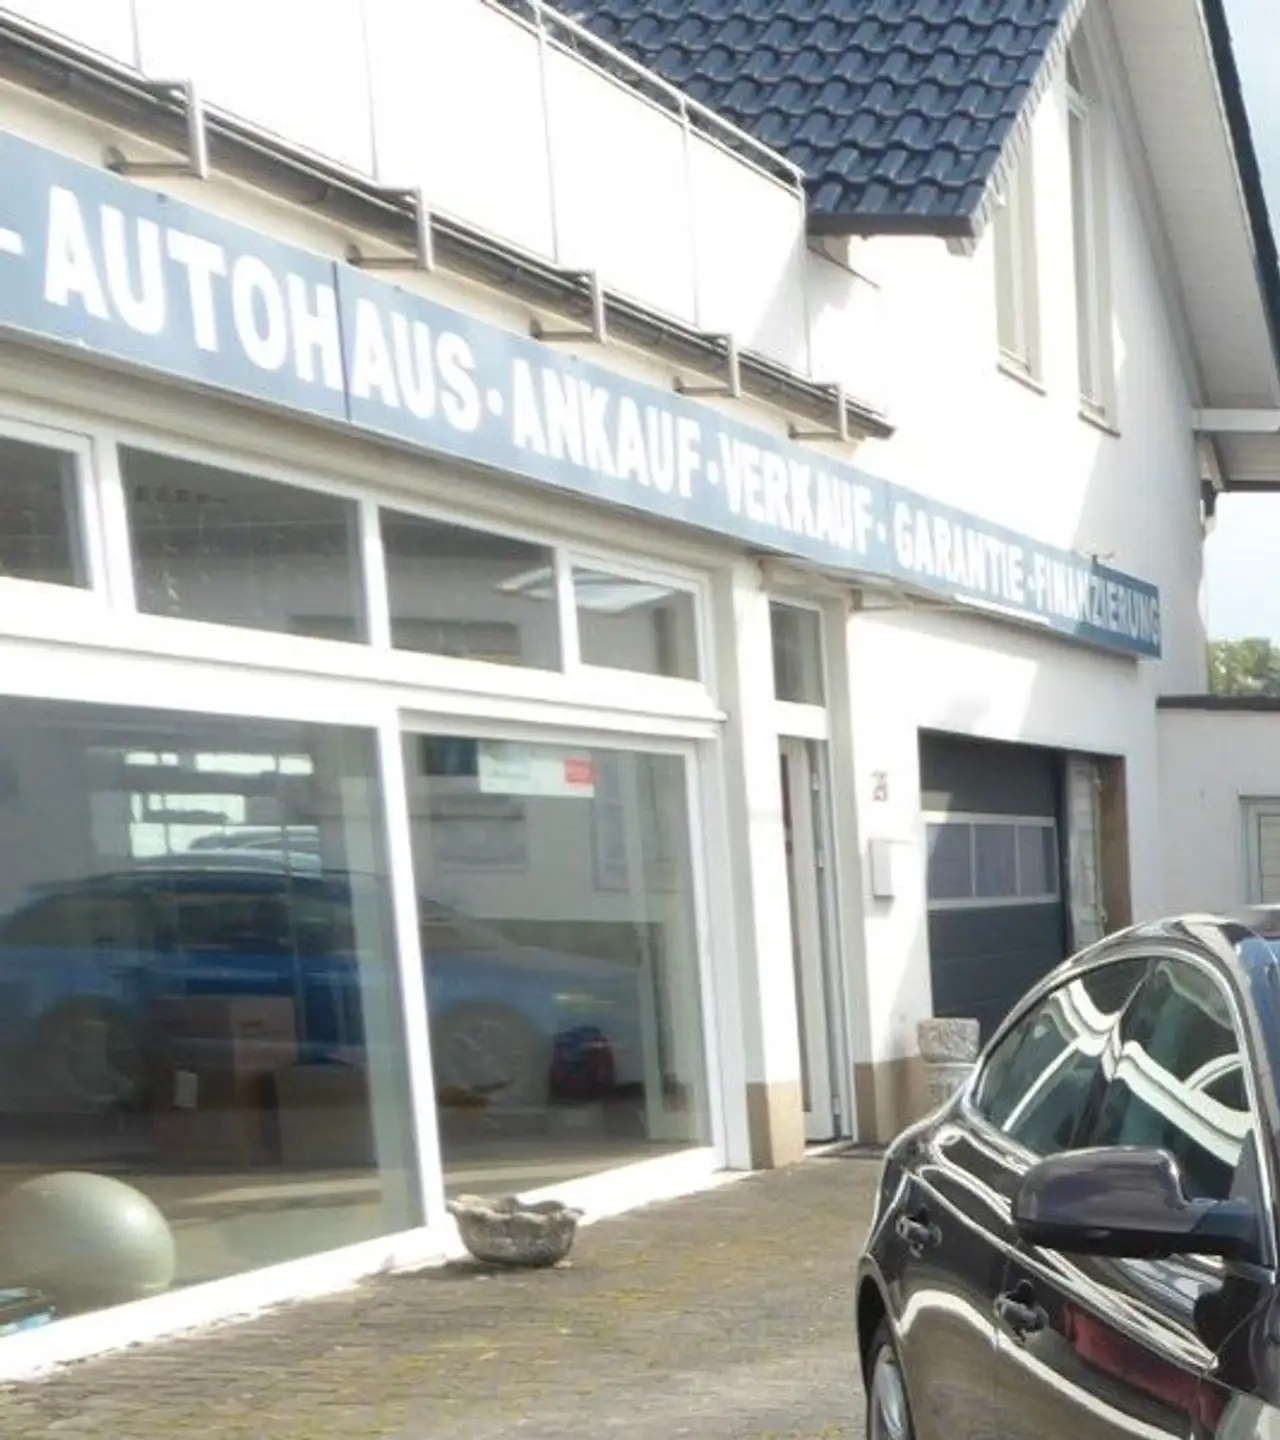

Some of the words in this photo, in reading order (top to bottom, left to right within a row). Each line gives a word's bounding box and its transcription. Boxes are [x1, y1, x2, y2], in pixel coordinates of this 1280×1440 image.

[44, 185, 482, 432] AUTOHAUS
[511, 357, 702, 499] ANKAUF
[718, 433, 873, 555] VERKAUF
[893, 501, 1025, 603] GARANTIE
